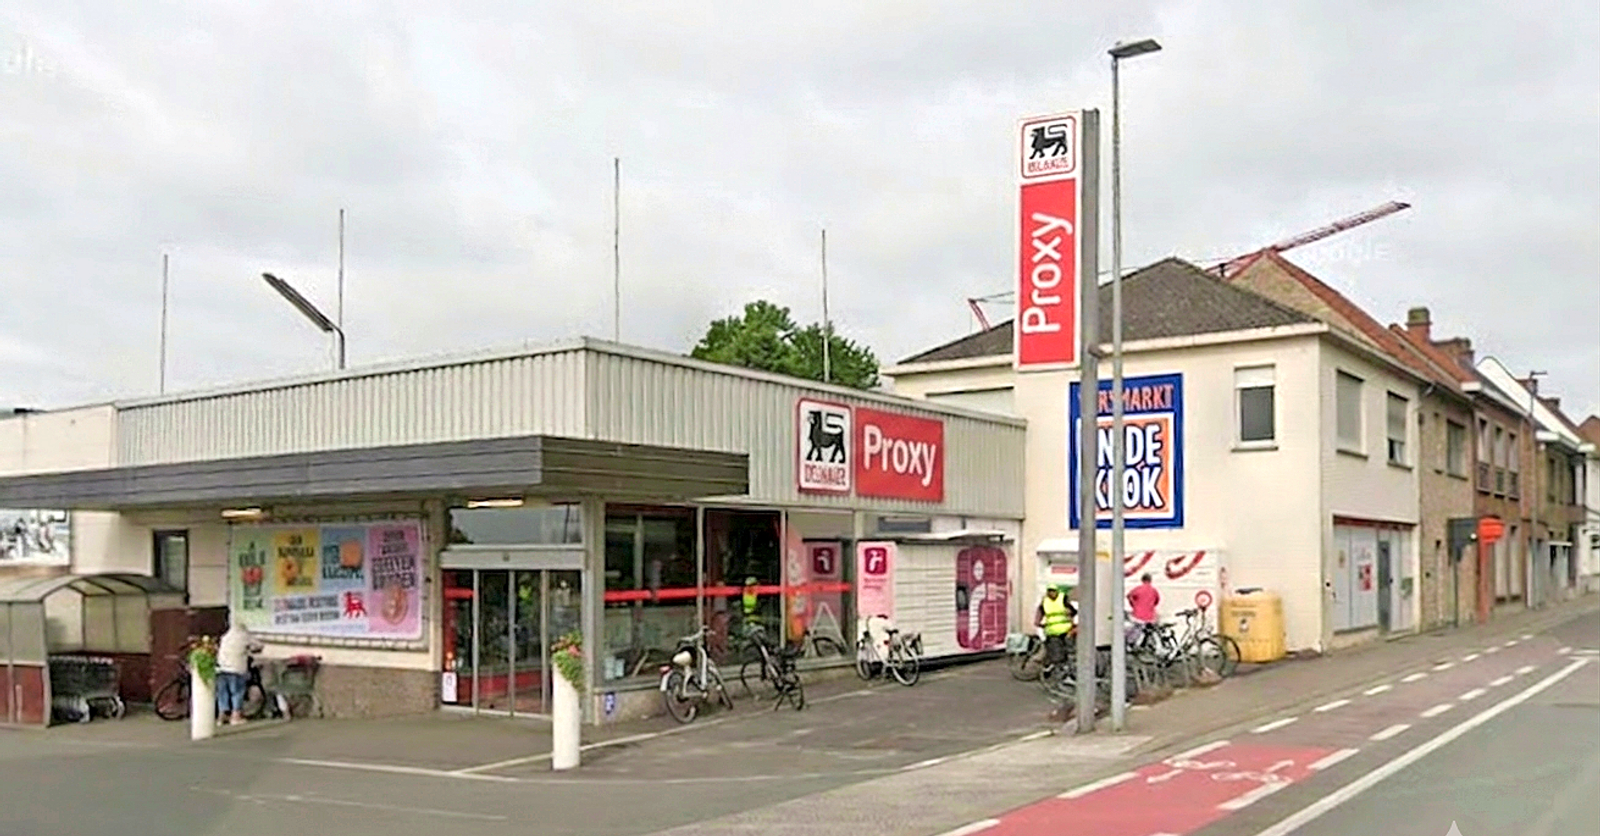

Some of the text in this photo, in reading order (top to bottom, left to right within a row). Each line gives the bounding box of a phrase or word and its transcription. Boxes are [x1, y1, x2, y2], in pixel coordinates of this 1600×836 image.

[1021, 212, 1074, 335] Proxy
[1078, 383, 1174, 413] RMARKT
[862, 423, 937, 488] Proxy
[1125, 422, 1163, 467] DE
